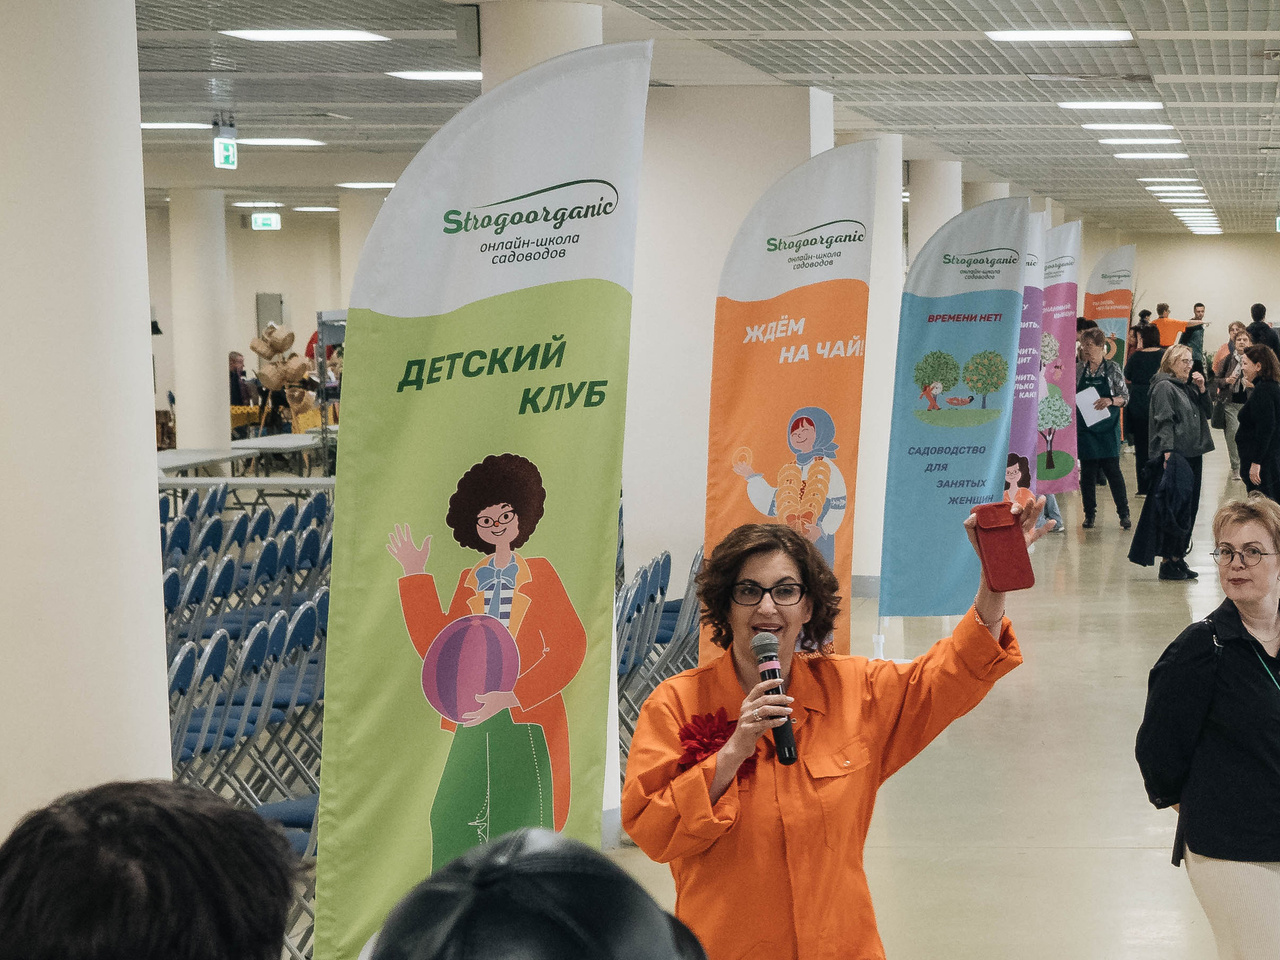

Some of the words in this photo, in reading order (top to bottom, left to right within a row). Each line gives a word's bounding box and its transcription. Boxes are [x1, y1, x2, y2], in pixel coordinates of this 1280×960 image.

[443, 196, 613, 235] Strogoorganic
[480, 234, 580, 253] онлайн-школа
[766, 230, 864, 253] Strogoorganic
[491, 248, 566, 265] садоводов
[787, 250, 841, 263] онлайн-школа
[943, 254, 1018, 268] Strogoorganic
[793, 259, 833, 270] садоводов
[927, 313, 978, 323] ВРЕМЕНИ
[979, 313, 1002, 323] НЕТ!
[743, 315, 806, 343] ЖДЁМ
[779, 344, 809, 364] НА
[816, 335, 865, 359] ЧАЙ!
[397, 334, 567, 393] ДЕТСКИЙ
[518, 380, 608, 415] КЛУБ
[908, 445, 986, 456] САДОВОДСТВО
[924, 463, 948, 473] ДЛЯ
[936, 479, 987, 488] ЗАНЯТЫХ
[948, 494, 994, 505] ЖЕНЩИН
